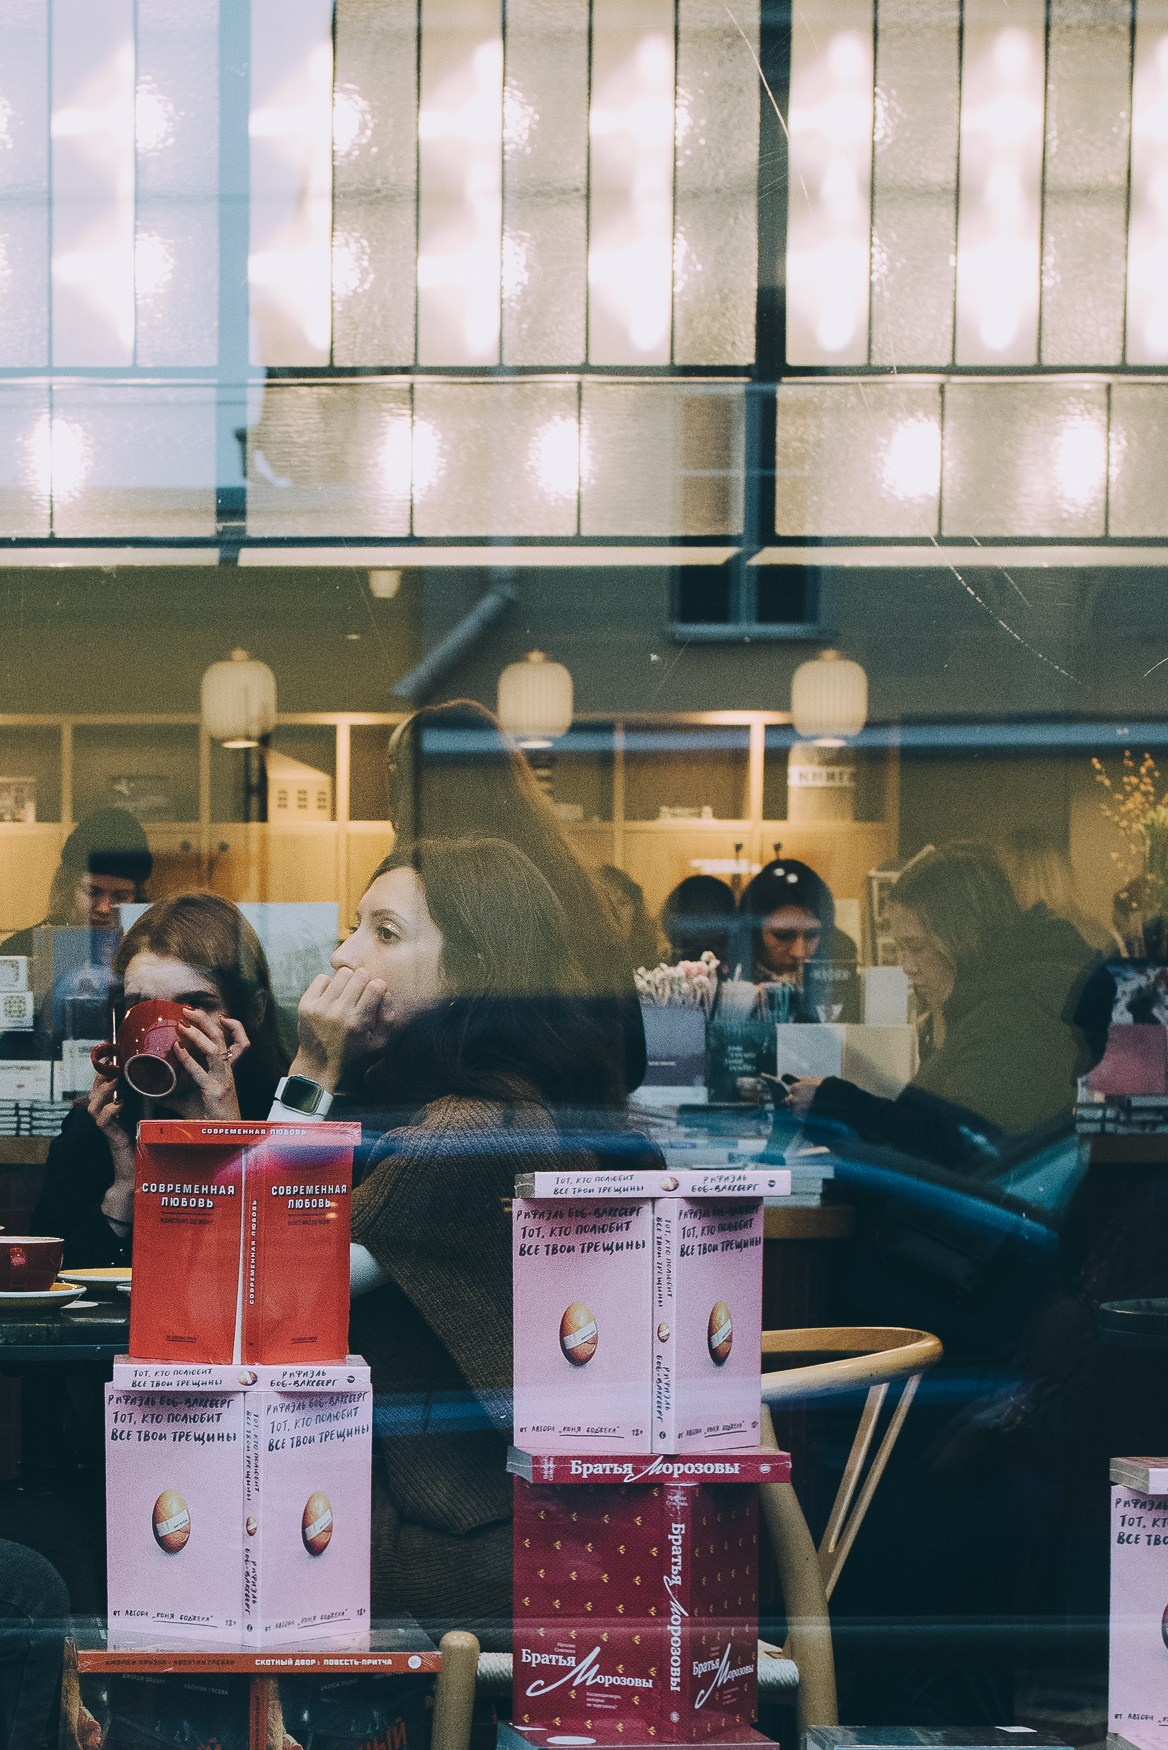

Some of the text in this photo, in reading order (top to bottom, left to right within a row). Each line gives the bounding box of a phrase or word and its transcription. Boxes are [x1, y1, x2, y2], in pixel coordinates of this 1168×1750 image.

[142, 1183, 235, 1195] СОВРЕМЕННАЯ
[271, 1184, 347, 1196] СОВРЕМЕННАЯ
[161, 1197, 214, 1209] ЛЮБОВЬ
[288, 1198, 331, 1209] ЛЮБОВЬ
[521, 1222, 631, 1239] ТОТ, КТО ПОЛЮБИТ
[519, 1239, 646, 1256] ВСЕ ТВОИ ТРЕЩИНЫ
[134, 1370, 151, 1378] ТОТ,
[173, 1368, 213, 1376] ПОЛЮБИТ
[131, 1380, 147, 1388] ВСЕ
[177, 1379, 223, 1387] ТРЕЩИНЫ
[112, 1411, 223, 1424] ТОТ, КТО ПОЛЮБИТ
[270, 1407, 359, 1435] ТОТ, КТО ПОЛЮБИТ
[111, 1428, 237, 1445] ВСЕ ТВОИ ТРЕЩИНЫ
[268, 1425, 370, 1452] ВСЕ ТВОИ ТРЕЩИНЫ
[570, 1460, 633, 1478] Братья
[624, 1455, 740, 1482] Морозовы
[1120, 1516, 1145, 1529] ТОТ,
[1117, 1531, 1168, 1546] ВСЕ ТВО
[669, 1523, 685, 1585] Братья
[663, 1575, 688, 1691] Морозовы
[521, 1646, 653, 1697] Братья Морозовы
[693, 1643, 753, 1708] Братья Морозовы
